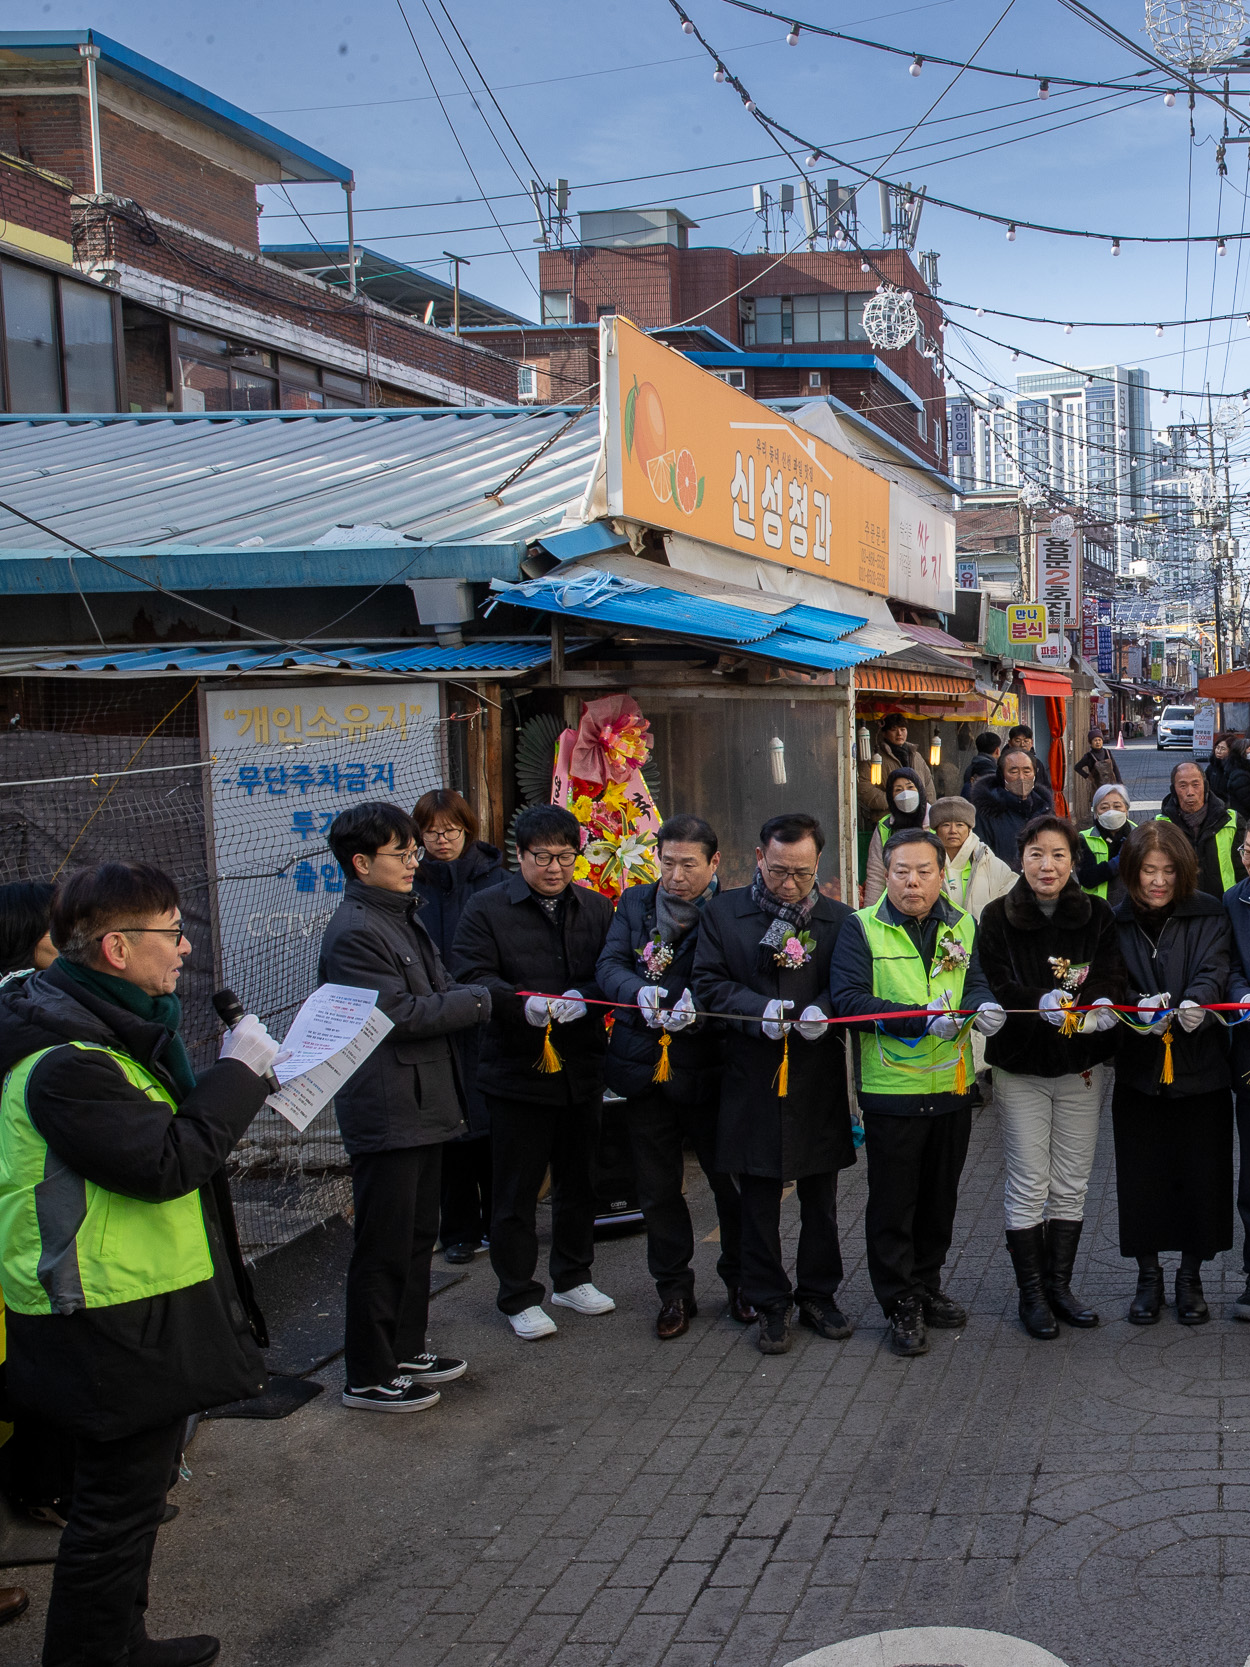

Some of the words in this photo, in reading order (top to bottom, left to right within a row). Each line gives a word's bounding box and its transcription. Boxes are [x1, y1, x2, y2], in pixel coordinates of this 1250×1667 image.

[955, 412, 968, 451] 어린이집
[730, 449, 832, 566] 신성청과
[1015, 609, 1038, 620] 만나
[1011, 622, 1043, 639] 분식
